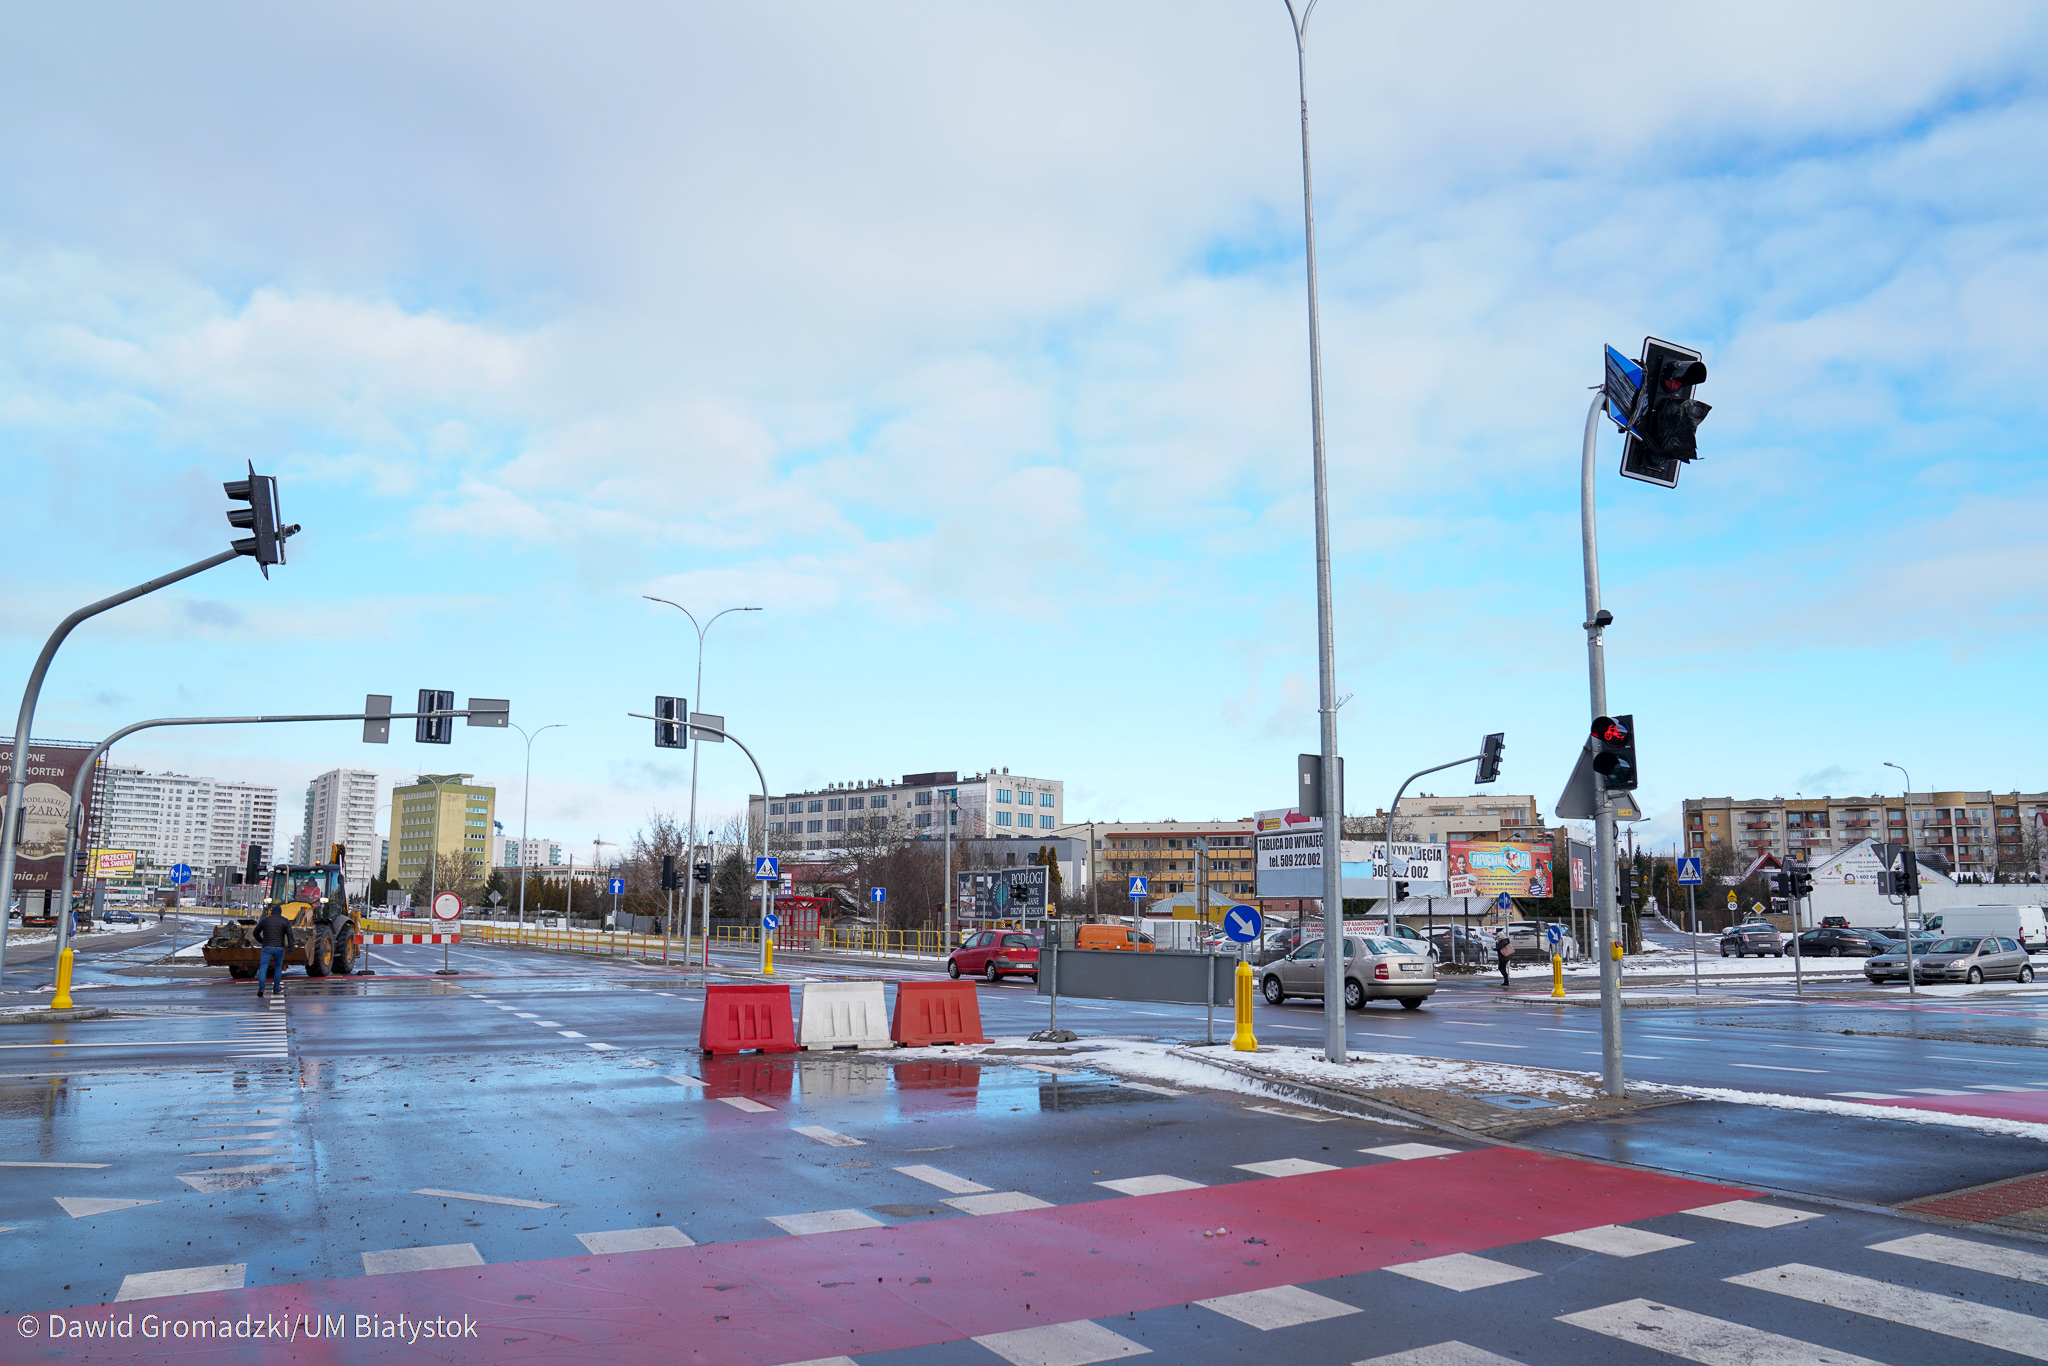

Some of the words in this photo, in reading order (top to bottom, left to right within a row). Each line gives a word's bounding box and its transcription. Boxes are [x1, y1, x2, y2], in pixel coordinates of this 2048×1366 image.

[1259, 838, 1284, 851] TABLICA
[1285, 837, 1293, 849] DO
[1294, 835, 1323, 849] WYNAJĘC
[1269, 855, 1279, 867] tel.
[1280, 854, 1293, 867] 509
[1294, 853, 1306, 866] 222
[1307, 852, 1320, 865] 002
[1412, 865, 1429, 878] 002
